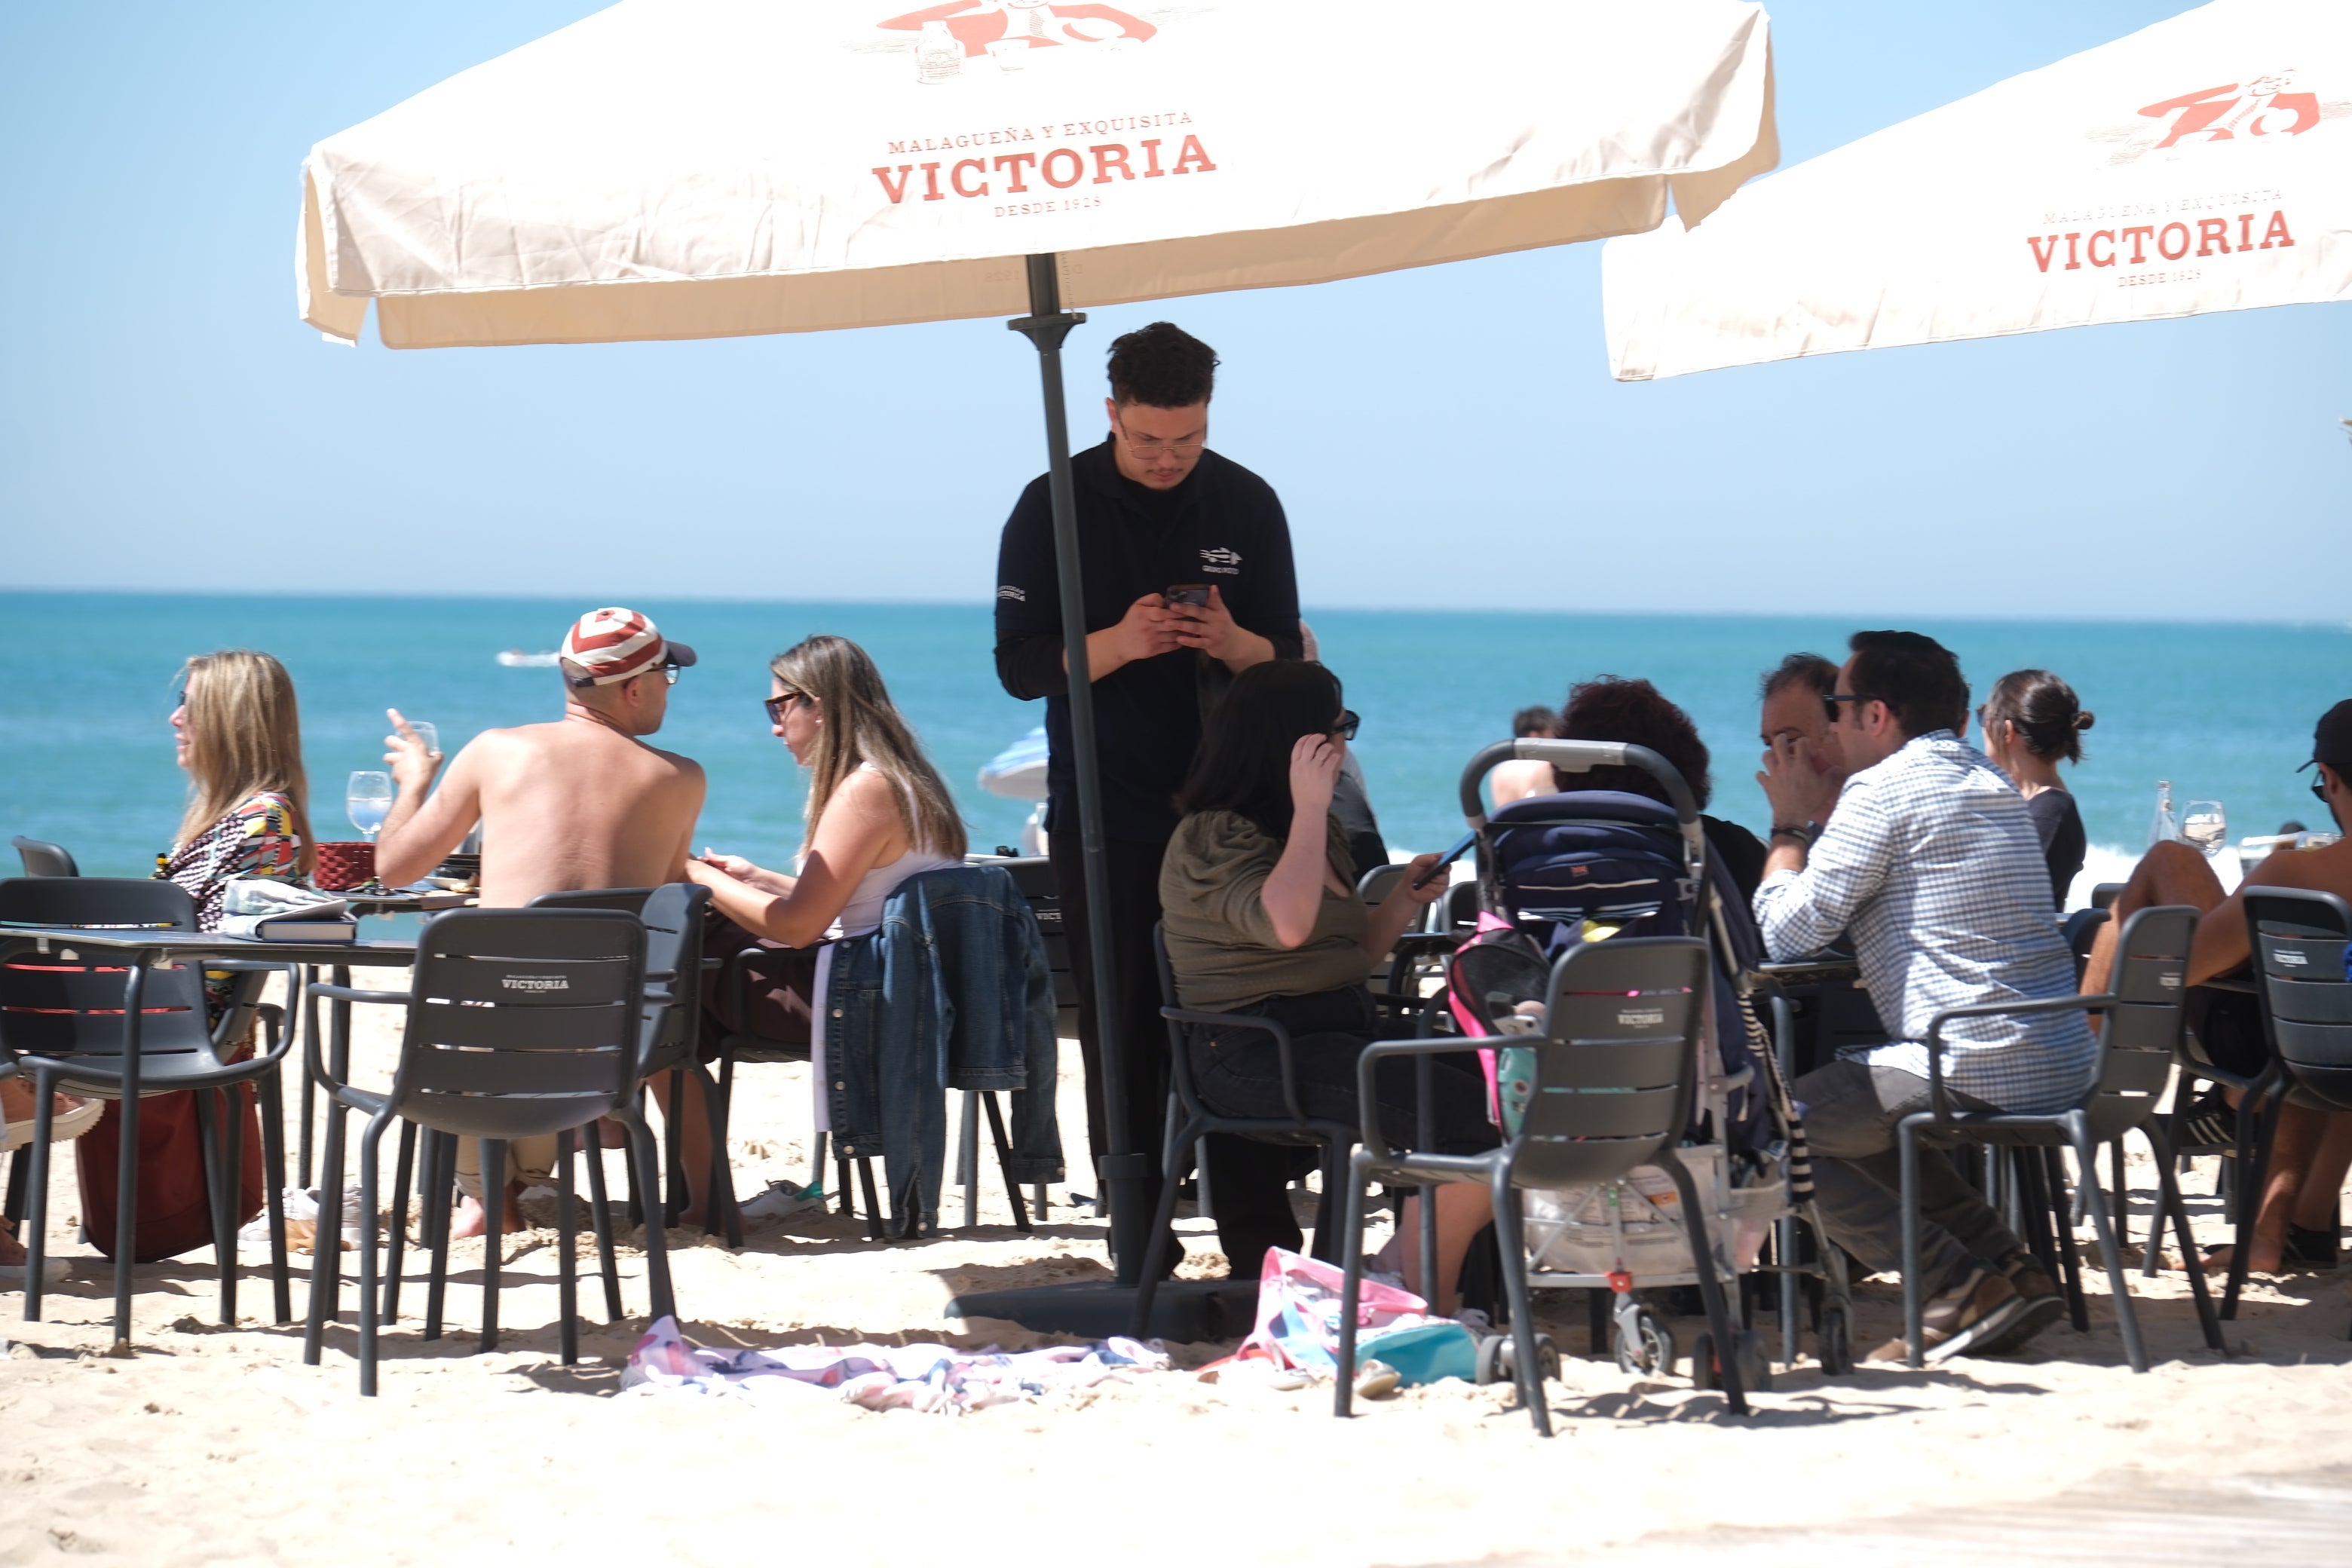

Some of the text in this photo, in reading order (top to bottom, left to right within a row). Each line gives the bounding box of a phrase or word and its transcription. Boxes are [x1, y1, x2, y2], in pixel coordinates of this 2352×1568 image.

[888, 112, 1193, 154] MALAGUEÑA Y EXQUISITA
[871, 133, 1217, 204] VICTORIA
[994, 201, 1057, 217] DESDE
[2026, 210, 2295, 273] VICTORIA
[2118, 272, 2167, 287] DESDE
[501, 979, 569, 989] VICTORIA
